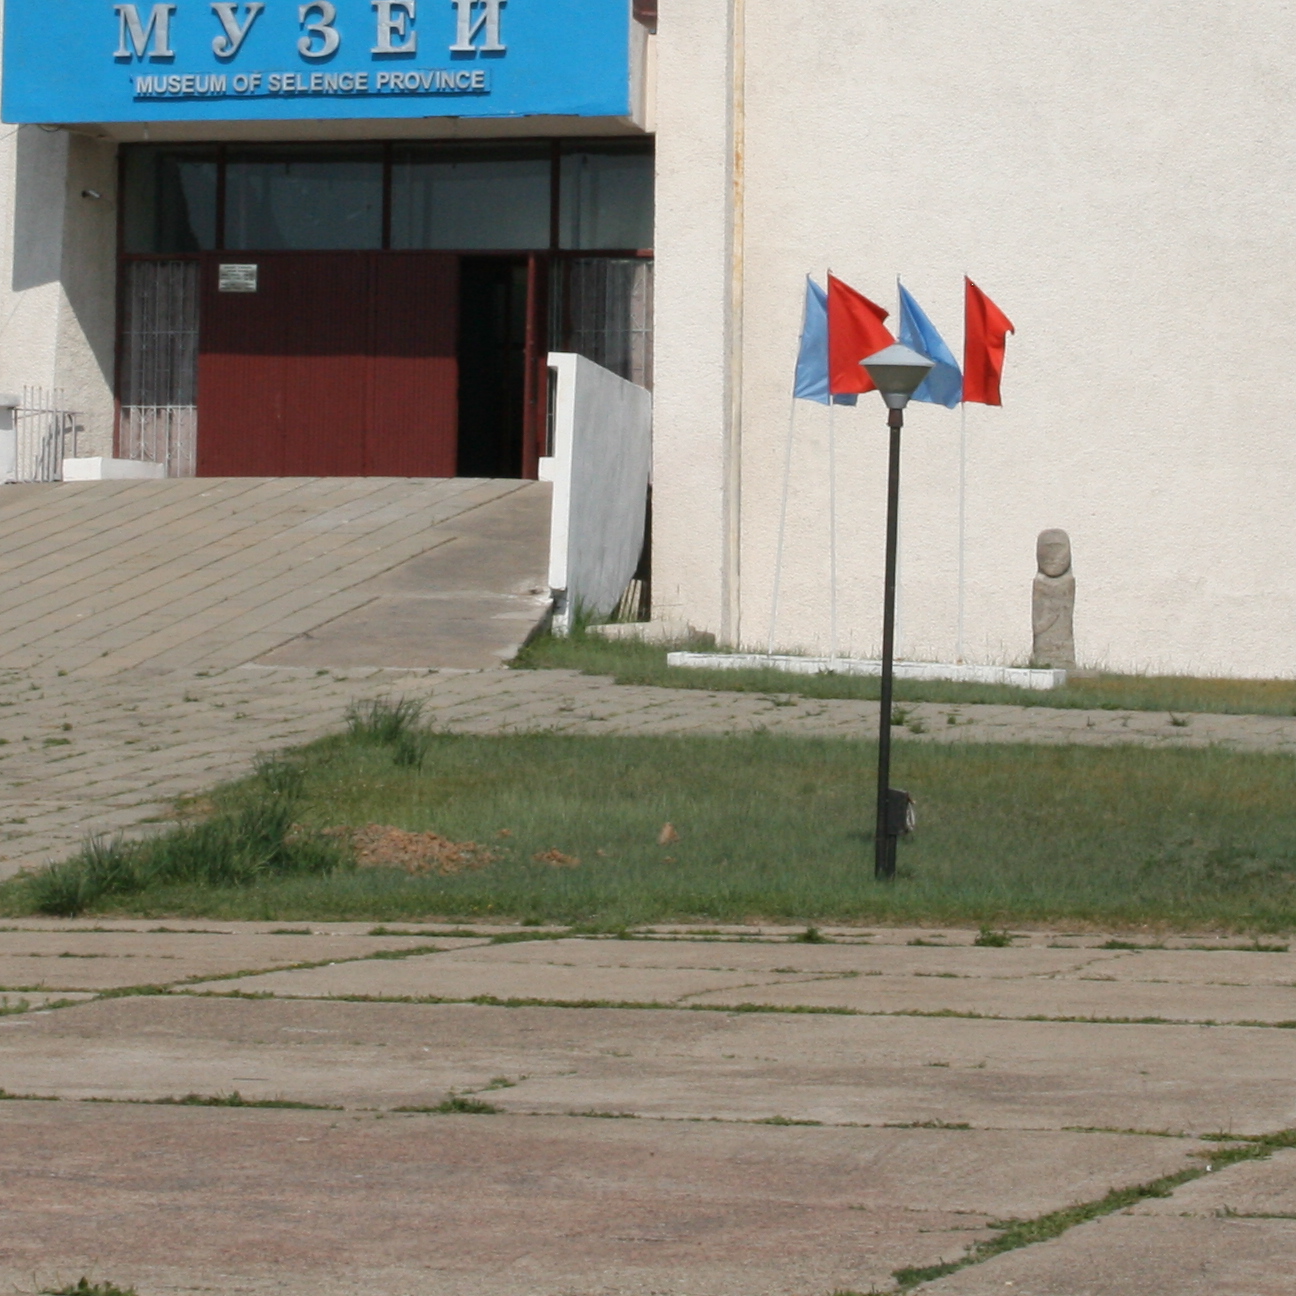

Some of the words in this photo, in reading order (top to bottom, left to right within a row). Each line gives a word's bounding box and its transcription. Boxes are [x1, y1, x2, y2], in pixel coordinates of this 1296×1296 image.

[136, 74, 226, 94] MUSEUM
[232, 73, 261, 93] OF
[268, 71, 368, 93] SELENGE
[376, 70, 485, 92] PROVINCE
